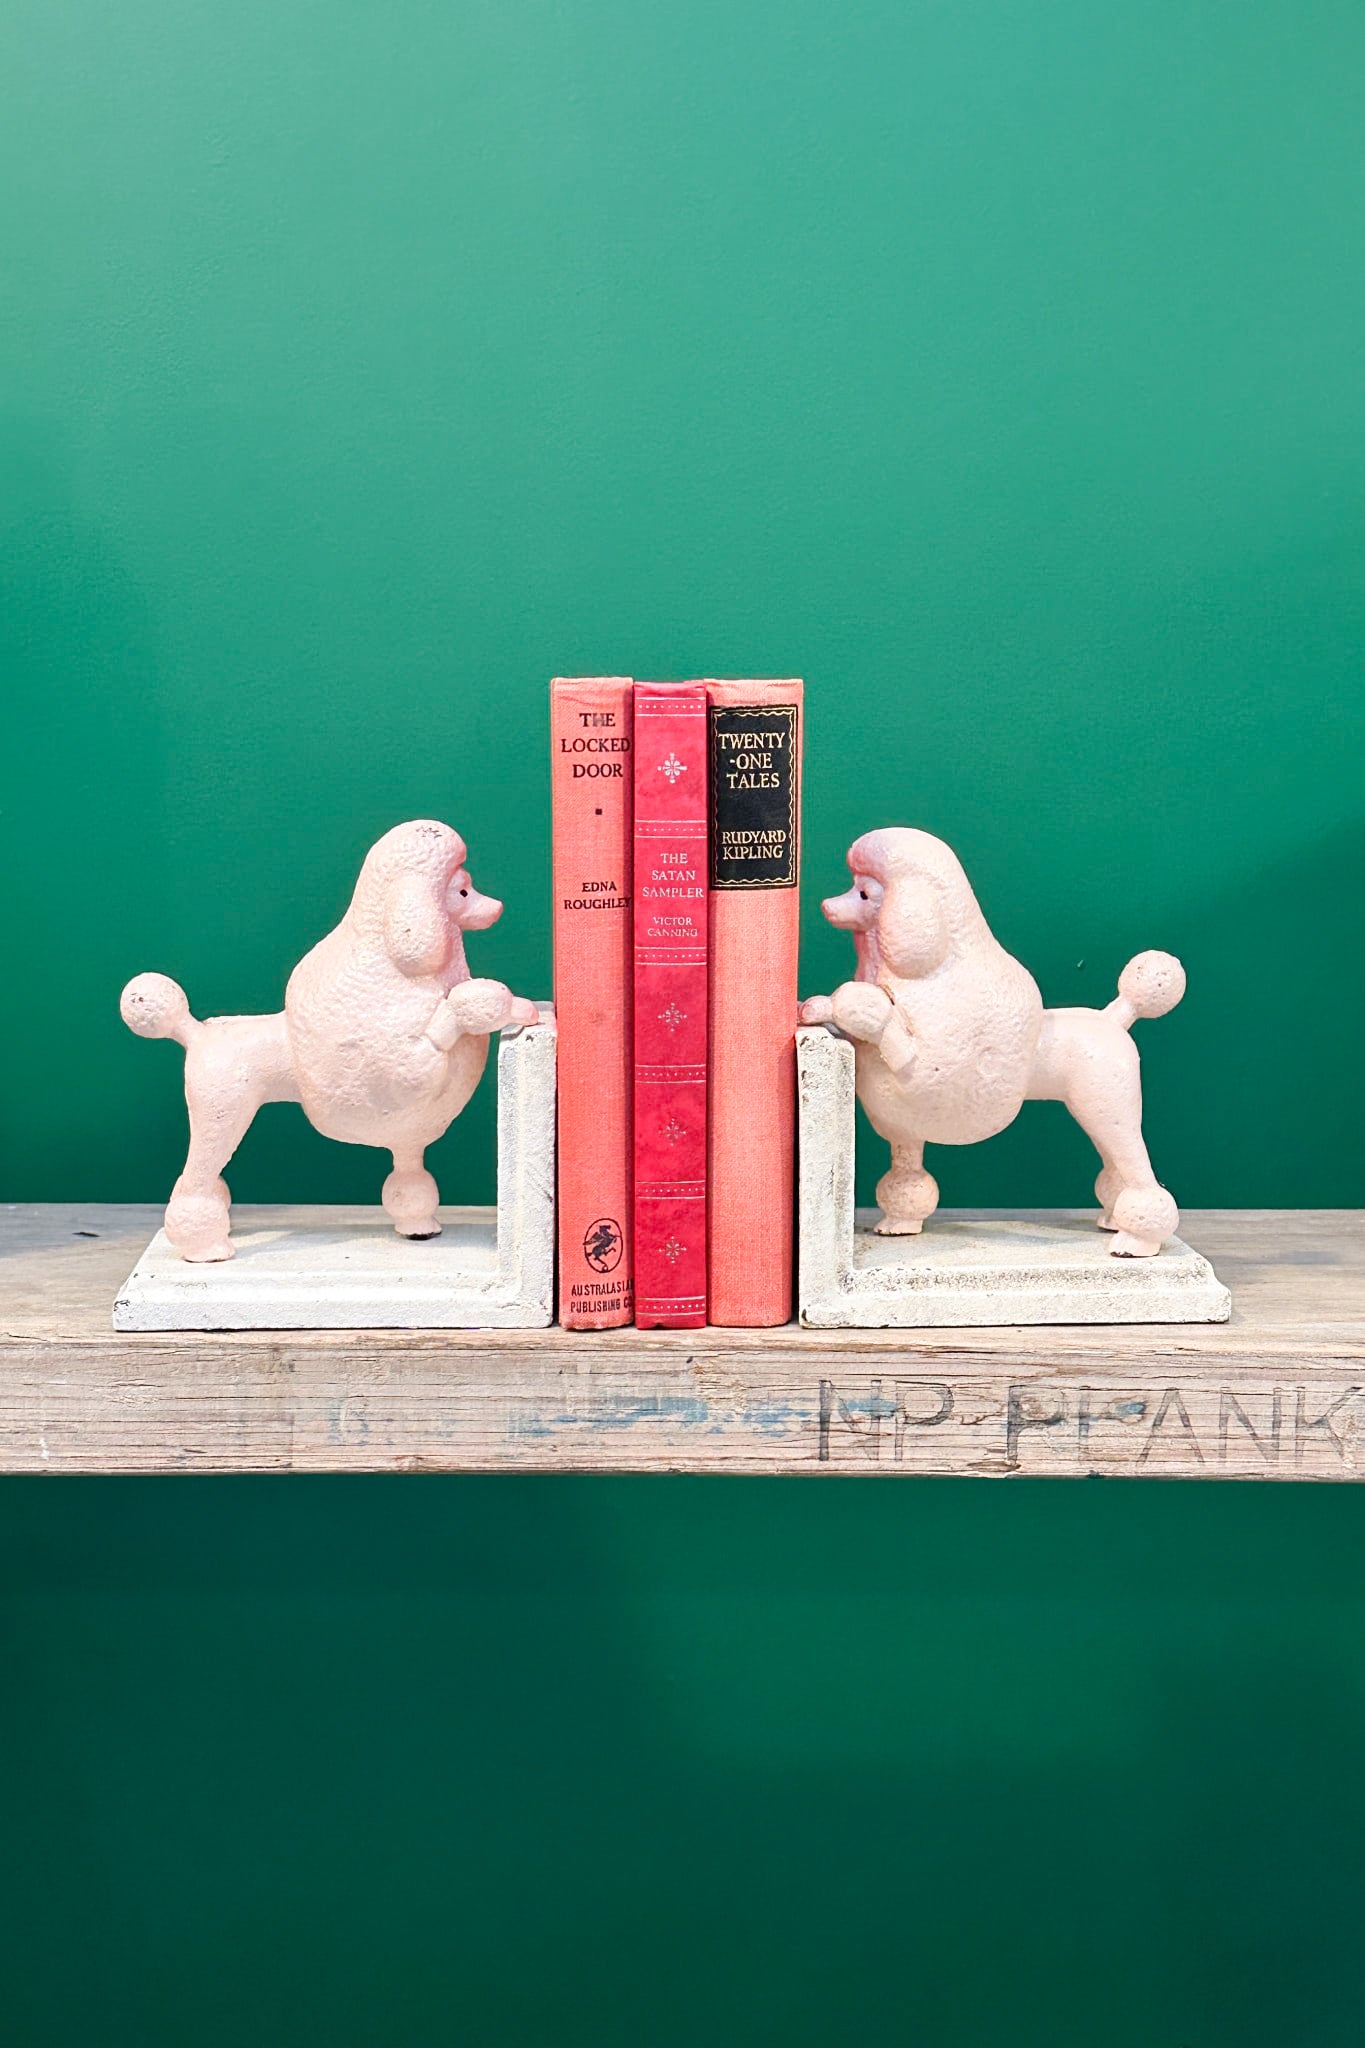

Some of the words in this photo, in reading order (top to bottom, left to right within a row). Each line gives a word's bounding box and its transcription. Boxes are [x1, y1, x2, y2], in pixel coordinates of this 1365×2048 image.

[579, 713, 616, 728] THE
[561, 738, 631, 753] LOCKED
[718, 732, 785, 749] TWENTY
[572, 763, 623, 778] DOOR
[726, 773, 780, 789] TALES
[722, 830, 786, 844] RUDYARD
[660, 853, 688, 864] THE
[723, 846, 783, 860] KIPLING
[651, 870, 696, 881] SATAN
[582, 881, 617, 893] EDNA
[642, 887, 704, 899] SAMPLER
[564, 897, 632, 910] ROUGHLEY
[653, 916, 692, 926] VICTOR
[647, 928, 698, 937] CANNING
[570, 1299, 621, 1313] PUBLISHING
